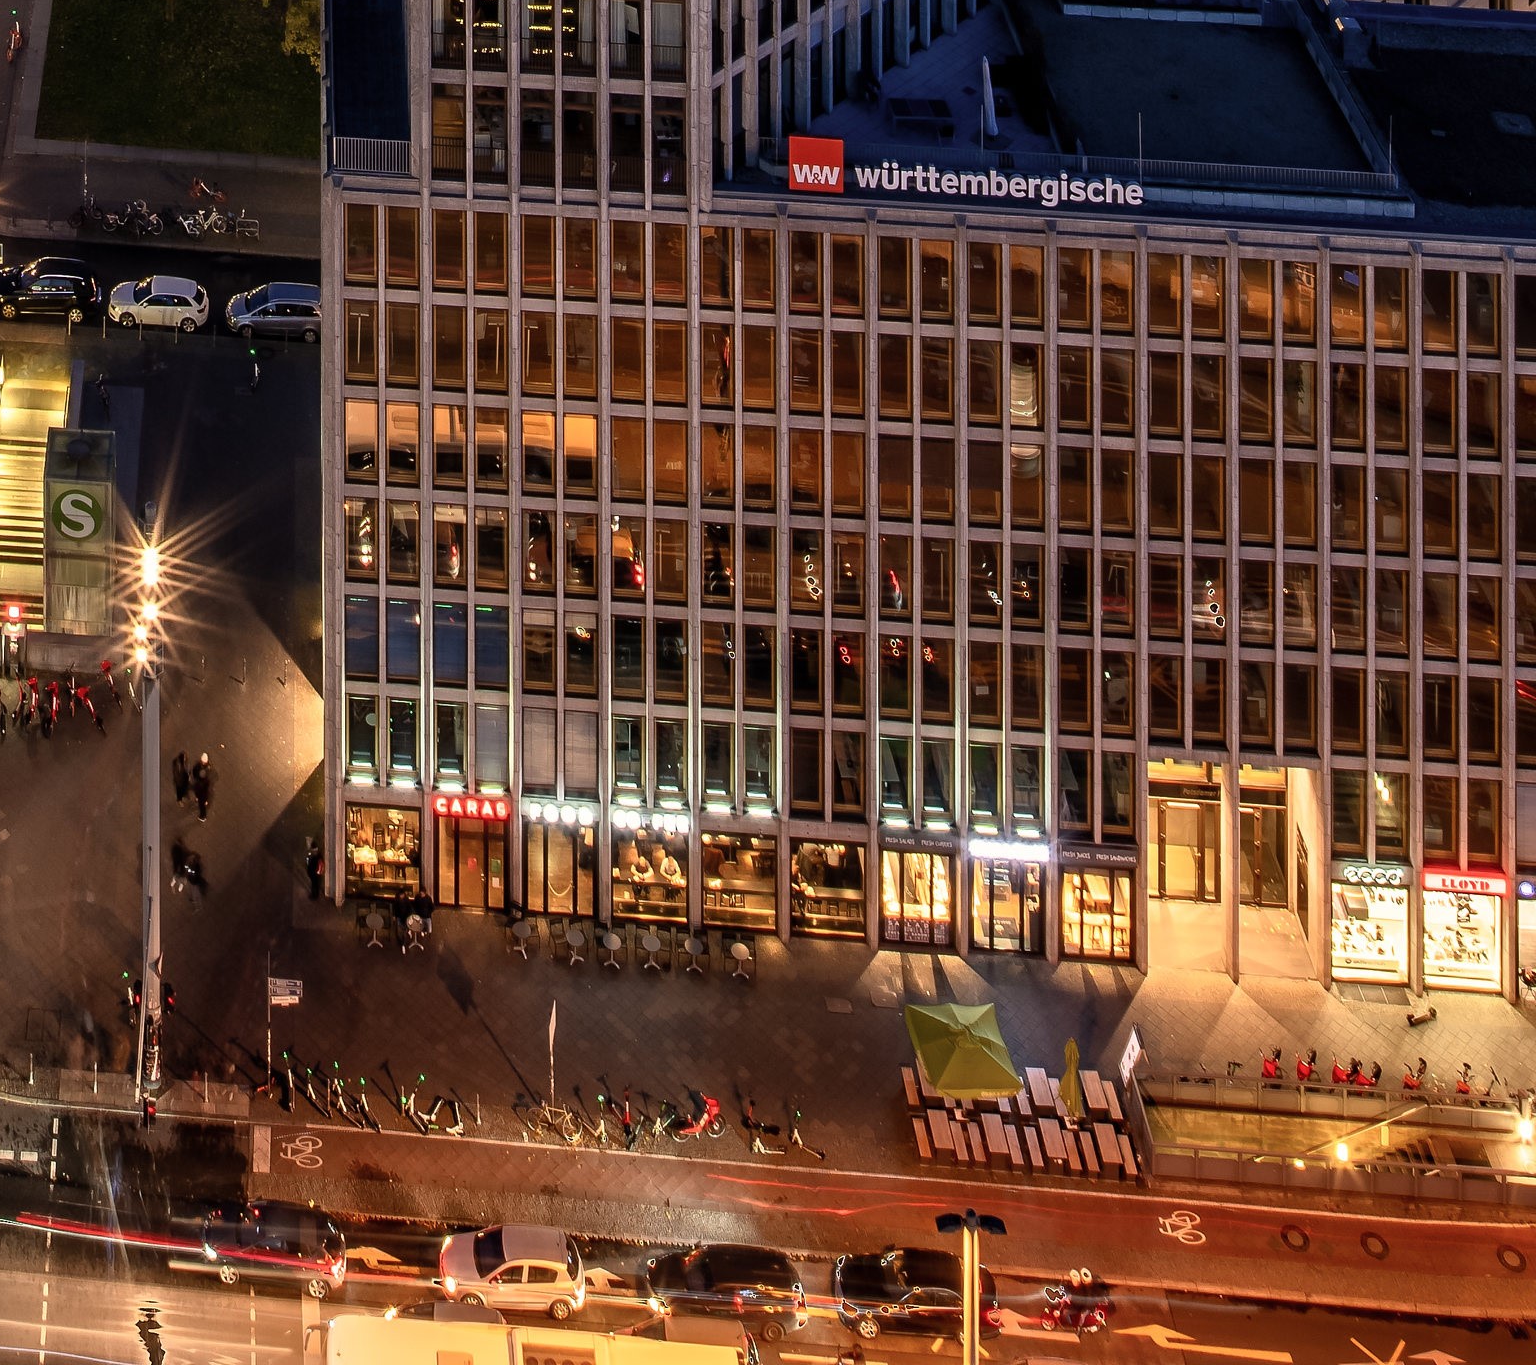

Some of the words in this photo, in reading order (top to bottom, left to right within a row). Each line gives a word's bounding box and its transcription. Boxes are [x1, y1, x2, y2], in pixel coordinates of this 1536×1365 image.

[792, 163, 841, 186] W&W
[855, 161, 1144, 208] württembergische
[60, 493, 96, 539] S
[436, 797, 507, 818] CARAS
[1062, 850, 1076, 859] FRESH
[1076, 852, 1091, 860] JUICES
[1096, 853, 1109, 861] FRESH
[1109, 854, 1136, 863] SANDWICHES
[1441, 878, 1490, 891] LLOYD
